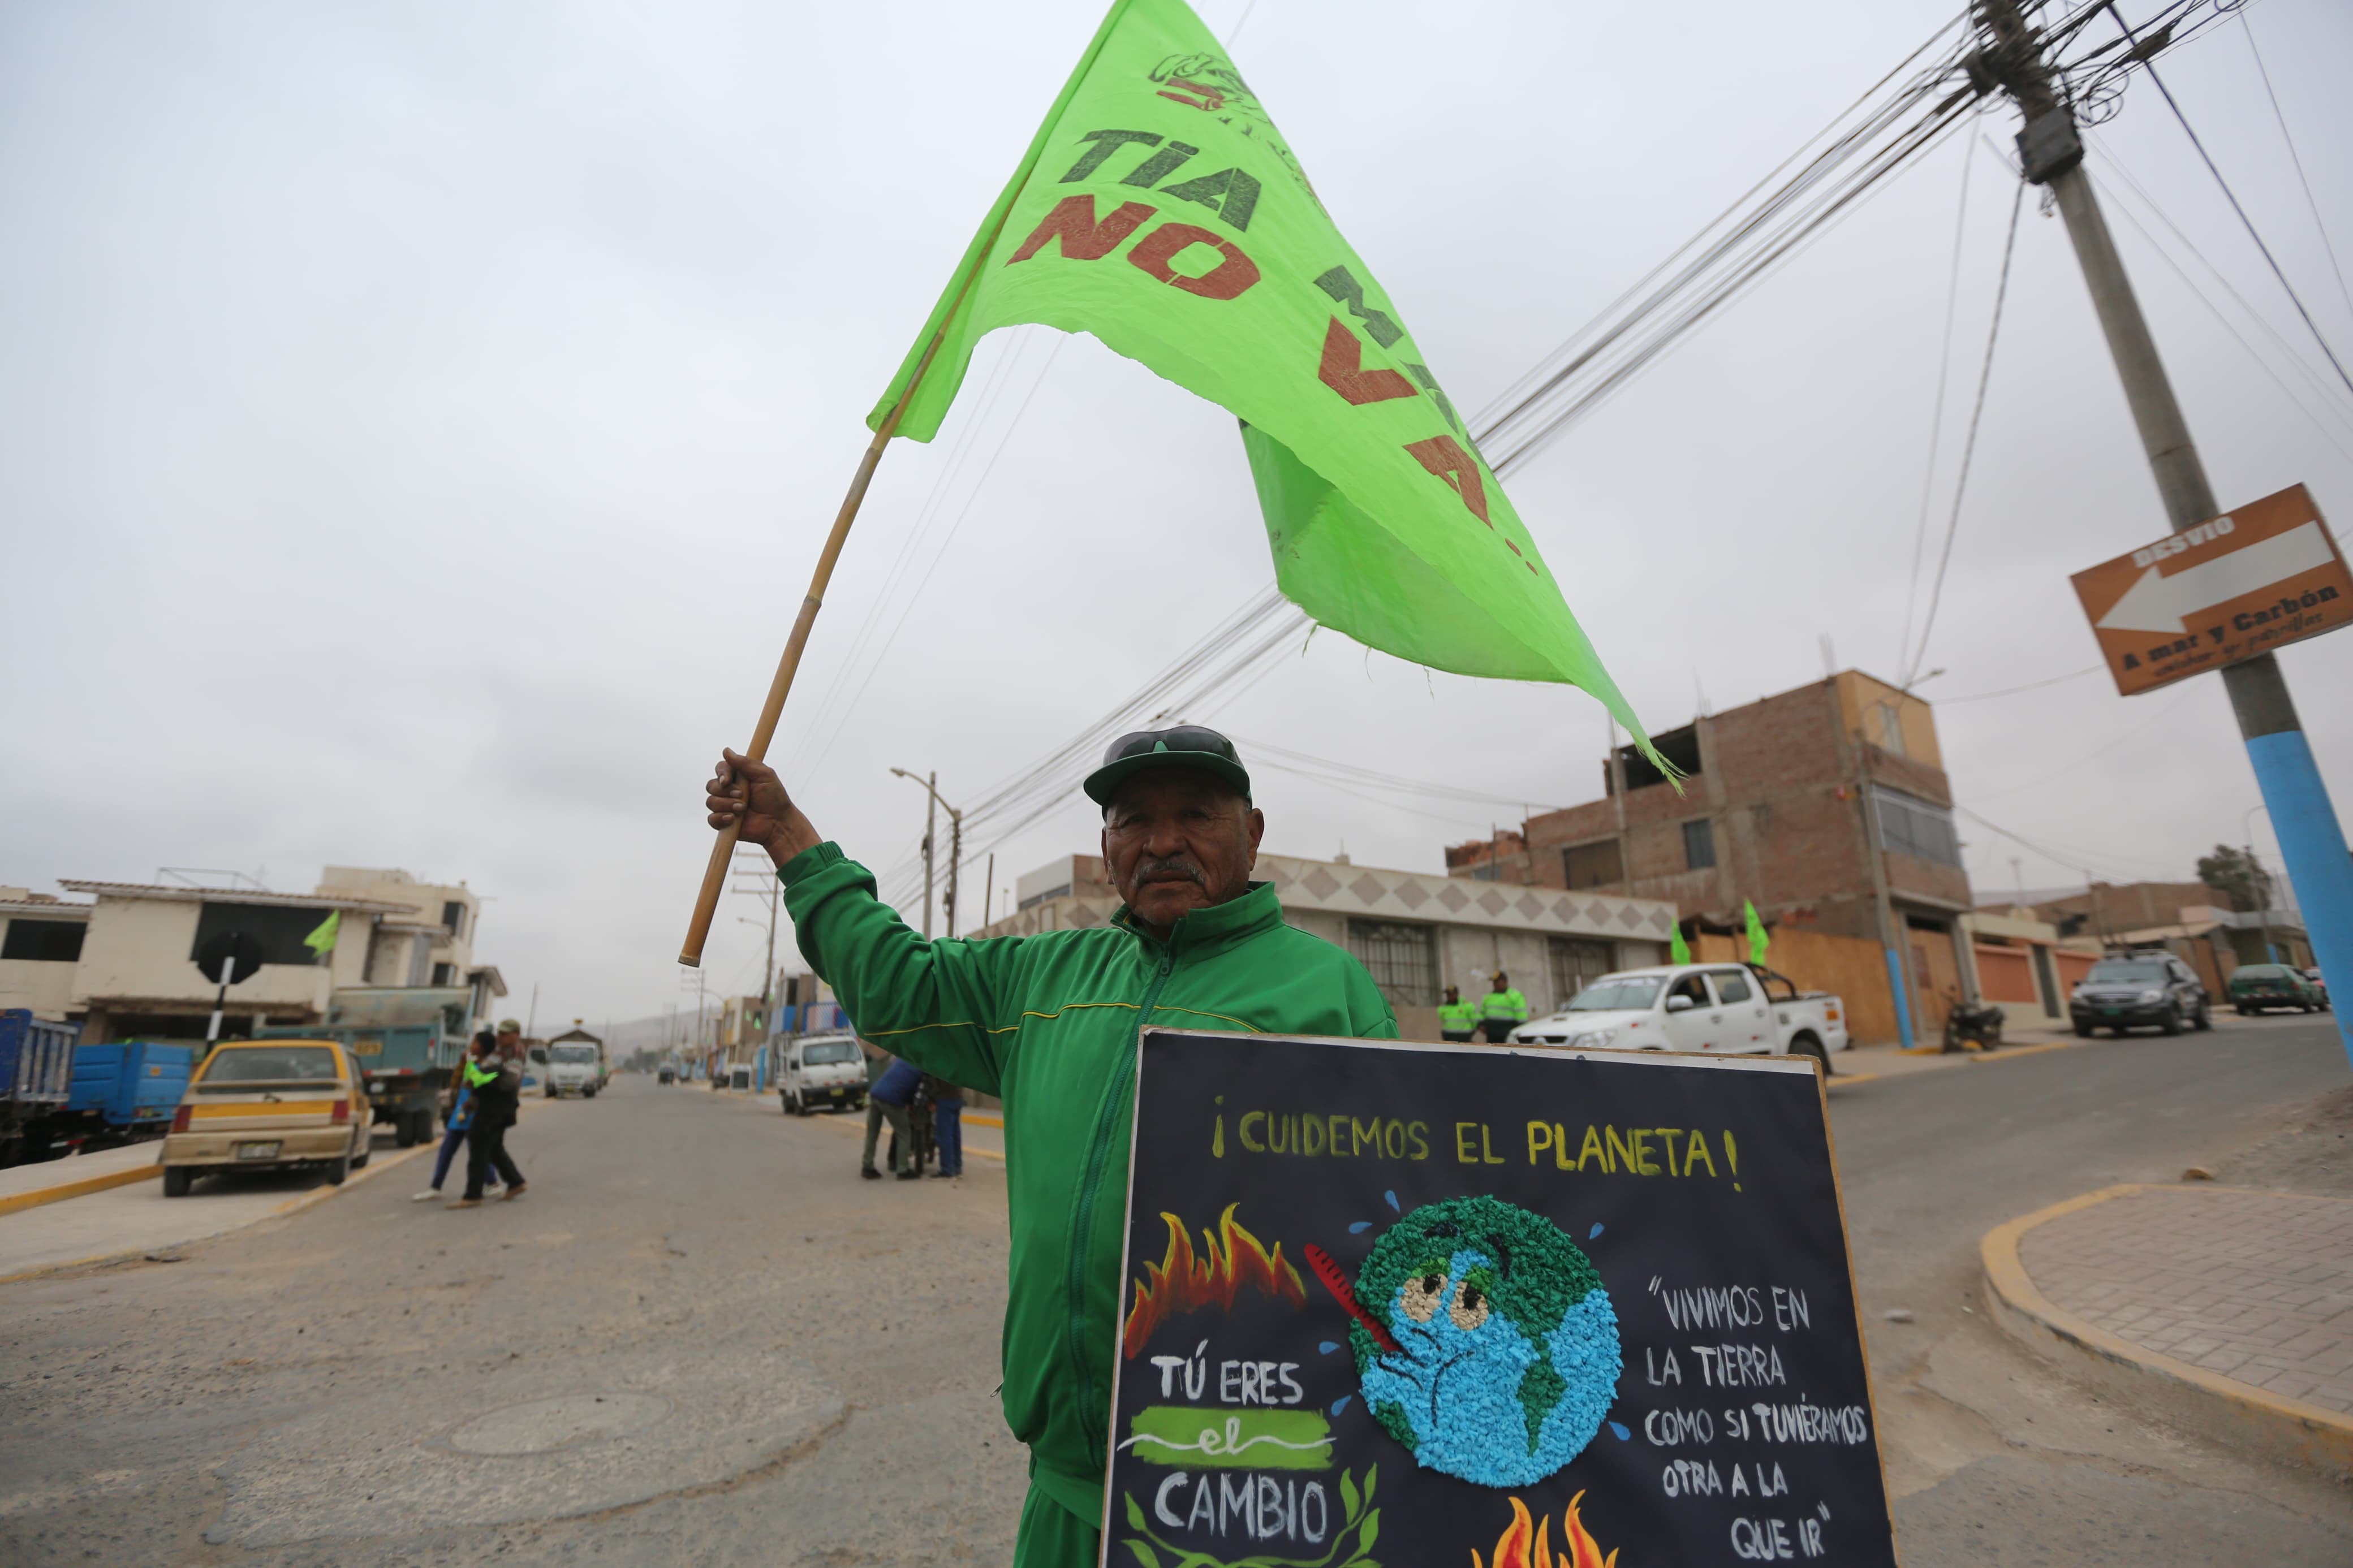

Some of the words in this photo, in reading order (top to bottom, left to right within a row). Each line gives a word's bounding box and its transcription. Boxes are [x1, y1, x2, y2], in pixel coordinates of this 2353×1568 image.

[1003, 194, 1261, 301] NO
[2131, 516, 2235, 568] DESVIO
[2123, 653, 2141, 670] A
[2148, 635, 2199, 661] mar
[2233, 586, 2340, 631] Carbón
[1456, 1122, 1506, 1164] EL
[1772, 1285, 1810, 1332] EN
[1150, 1338, 1209, 1400] TÚ
[1221, 1359, 1303, 1406] ERES
[1647, 1347, 1682, 1386] LA
[1691, 1343, 1786, 1387] TIERRA
[1198, 1416, 1246, 1457] el
[1645, 1406, 1714, 1446] COMO
[1724, 1409, 1750, 1441] SI
[1662, 1459, 1723, 1498] OTRA
[1732, 1463, 1750, 1498] A
[1756, 1461, 1788, 1497] LA
[1154, 1472, 1327, 1544] CAMBIO
[1731, 1518, 1794, 1561] QUE
